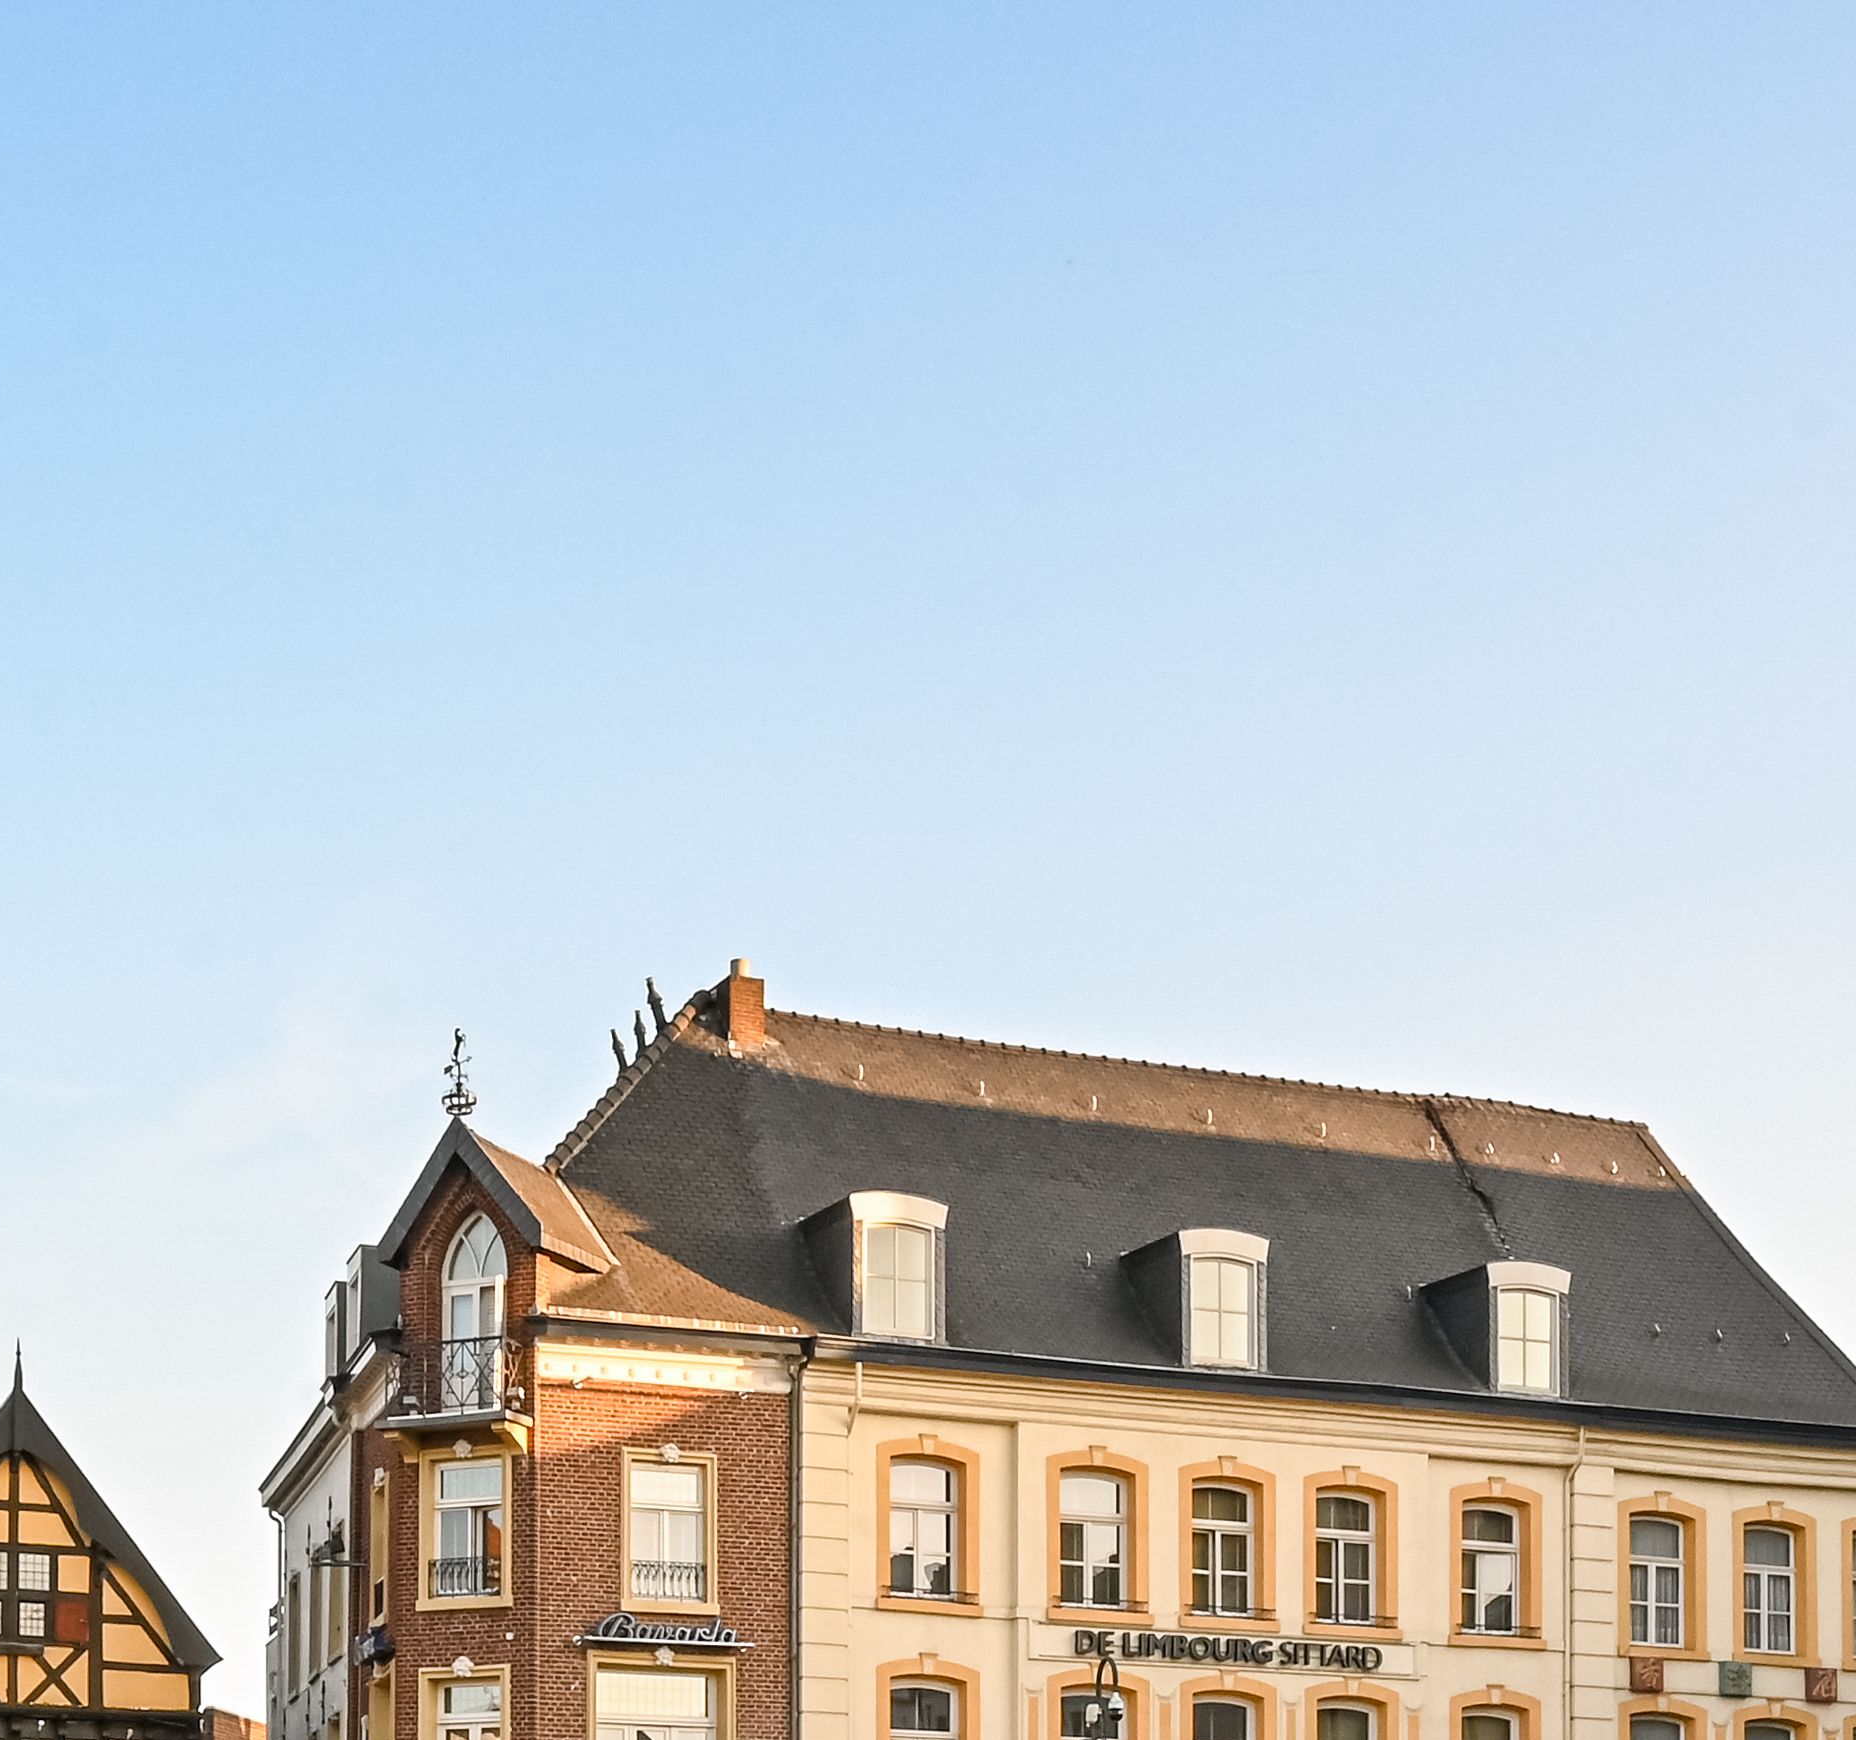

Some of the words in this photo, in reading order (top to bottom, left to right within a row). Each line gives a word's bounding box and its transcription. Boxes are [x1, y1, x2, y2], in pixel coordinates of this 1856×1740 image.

[599, 1612, 738, 1643] Bavaria
[1075, 1629, 1115, 1656] DE
[1122, 1632, 1274, 1664] LIMBOURG
[1278, 1641, 1384, 1673] SITTARD
